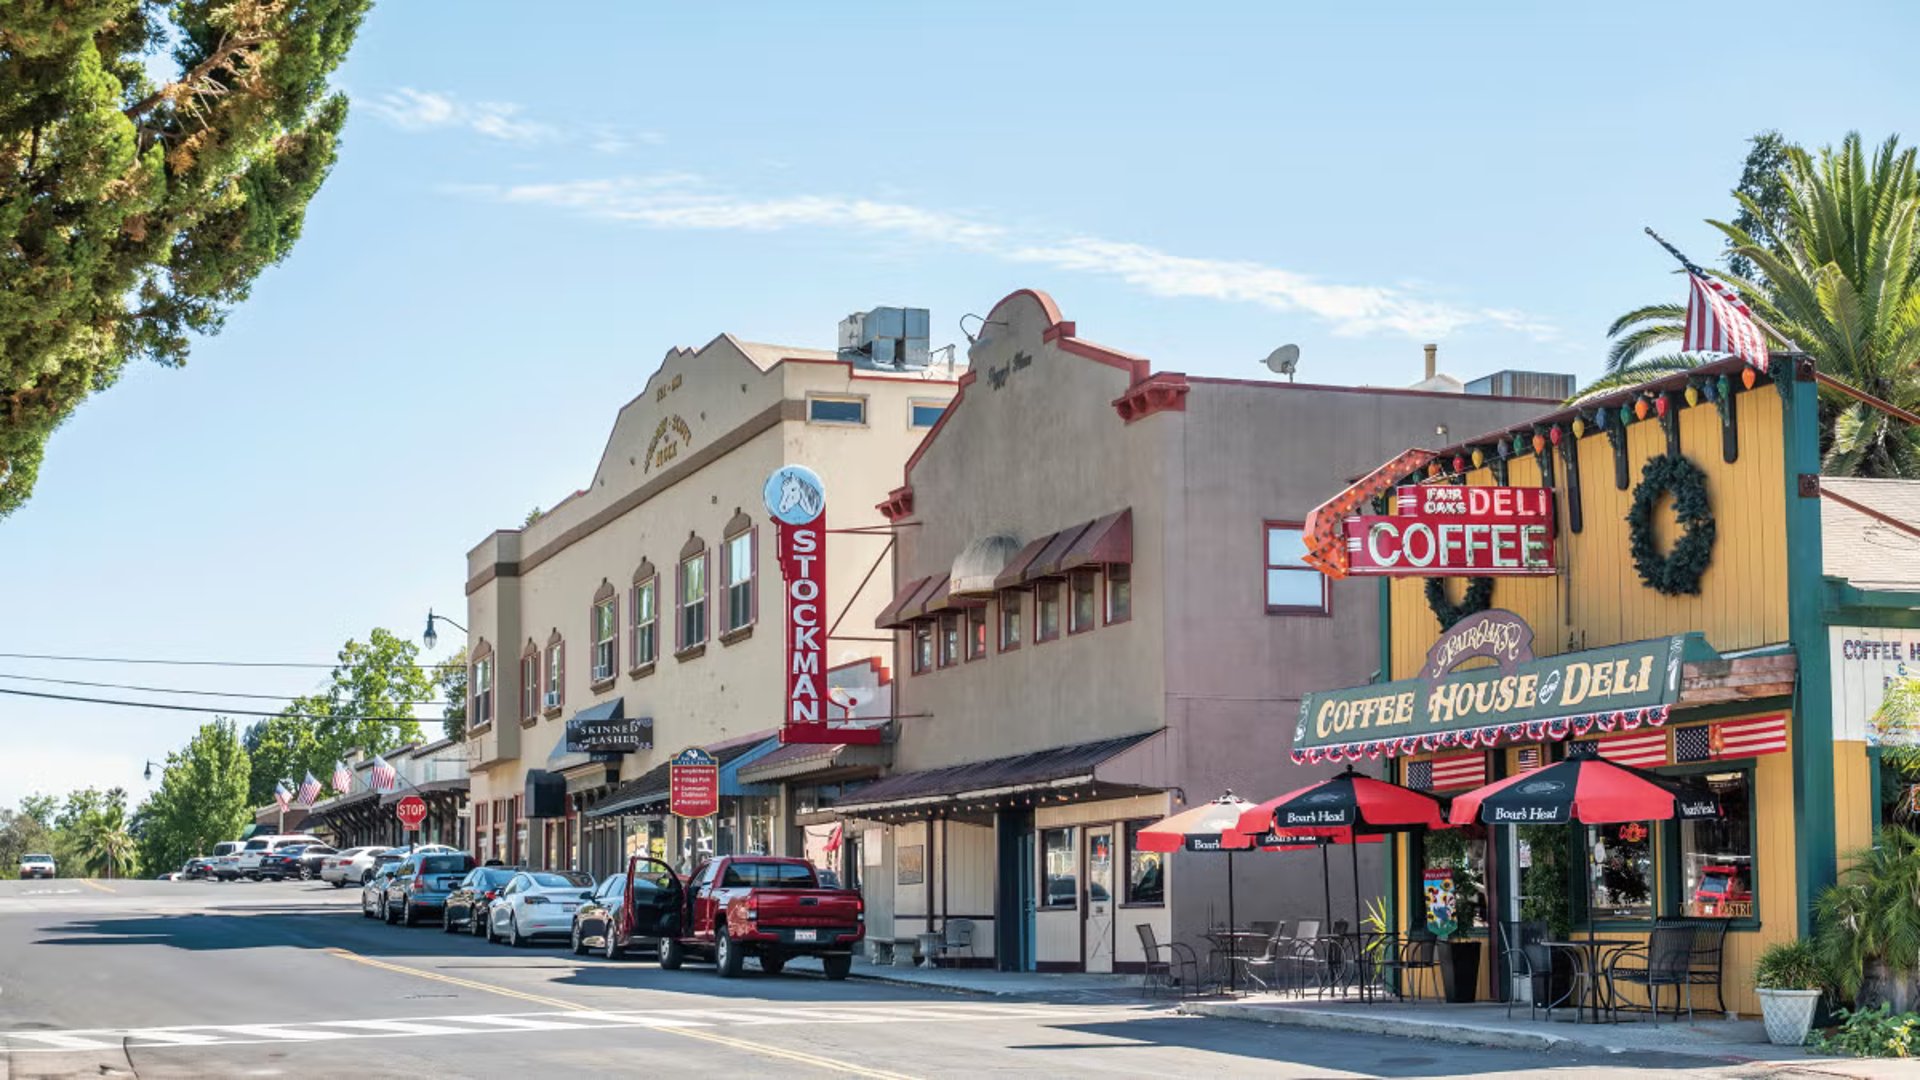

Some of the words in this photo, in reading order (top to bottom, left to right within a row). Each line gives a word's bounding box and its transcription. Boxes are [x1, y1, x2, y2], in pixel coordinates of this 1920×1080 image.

[1368, 521, 1549, 567] COFFEE
[790, 530, 820, 724] STOCKMAN
[1843, 640, 1902, 660] COFFEE
[1316, 691, 1416, 739] COFFEE
[1427, 672, 1539, 724] HOUSE
[1559, 656, 1654, 706] DELI
[581, 725, 639, 735] SKINNED
[591, 735, 639, 745] LASHED
[400, 804, 425, 816] STOP
[1287, 811, 1316, 823] Boar's
[1318, 809, 1345, 822] Head
[1495, 807, 1527, 820] Boar's
[1529, 806, 1558, 820] Head
